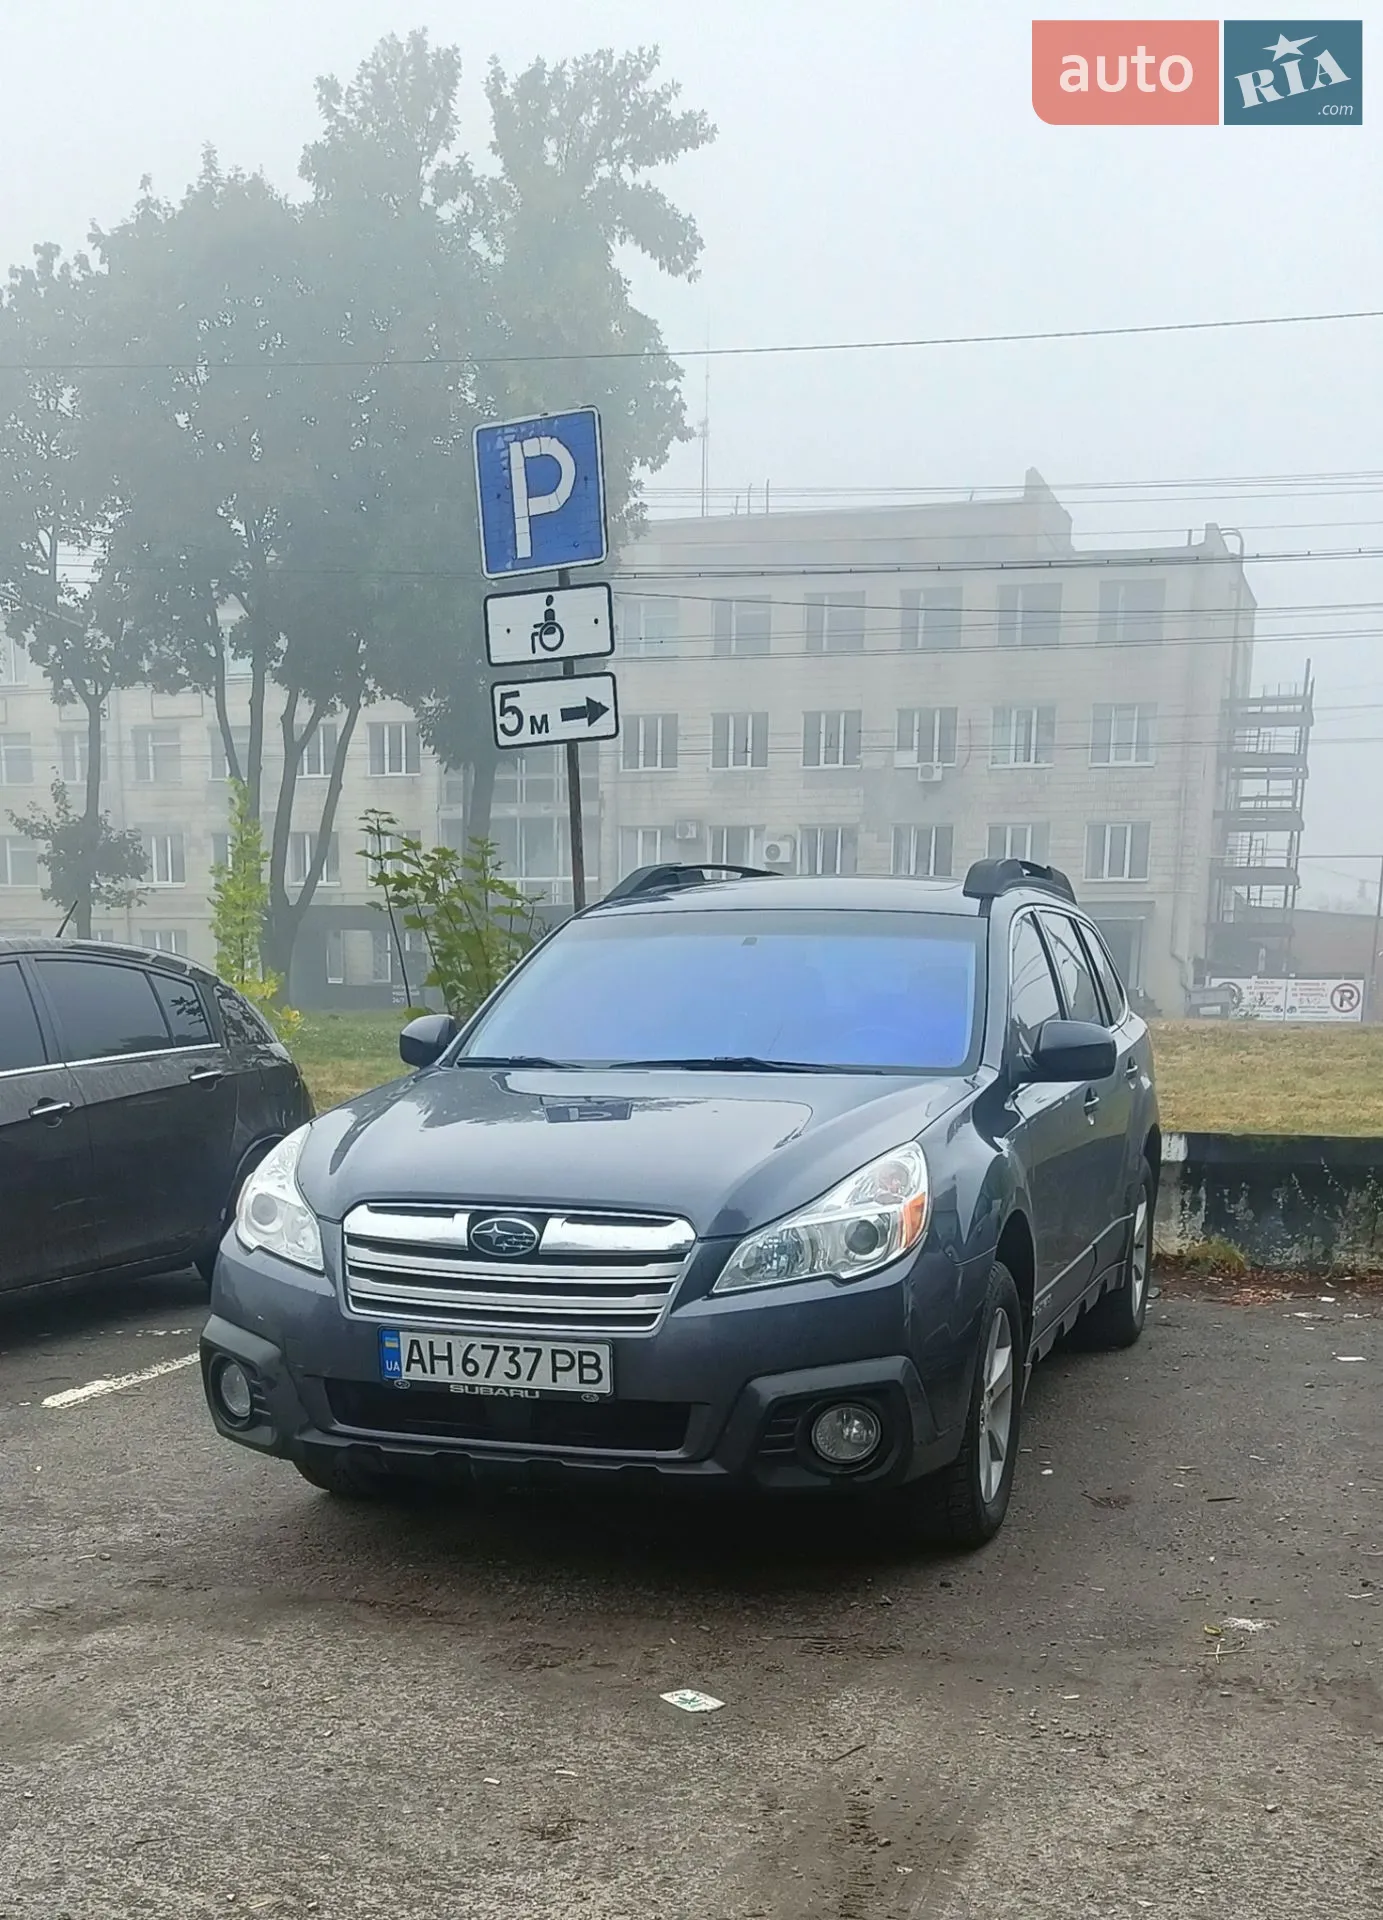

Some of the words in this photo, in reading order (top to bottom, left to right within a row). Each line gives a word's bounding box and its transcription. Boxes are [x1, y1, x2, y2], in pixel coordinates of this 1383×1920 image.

[508, 435, 577, 560] P
[385, 1360, 401, 1373] UA
[449, 1383, 540, 1399] SUBARU
